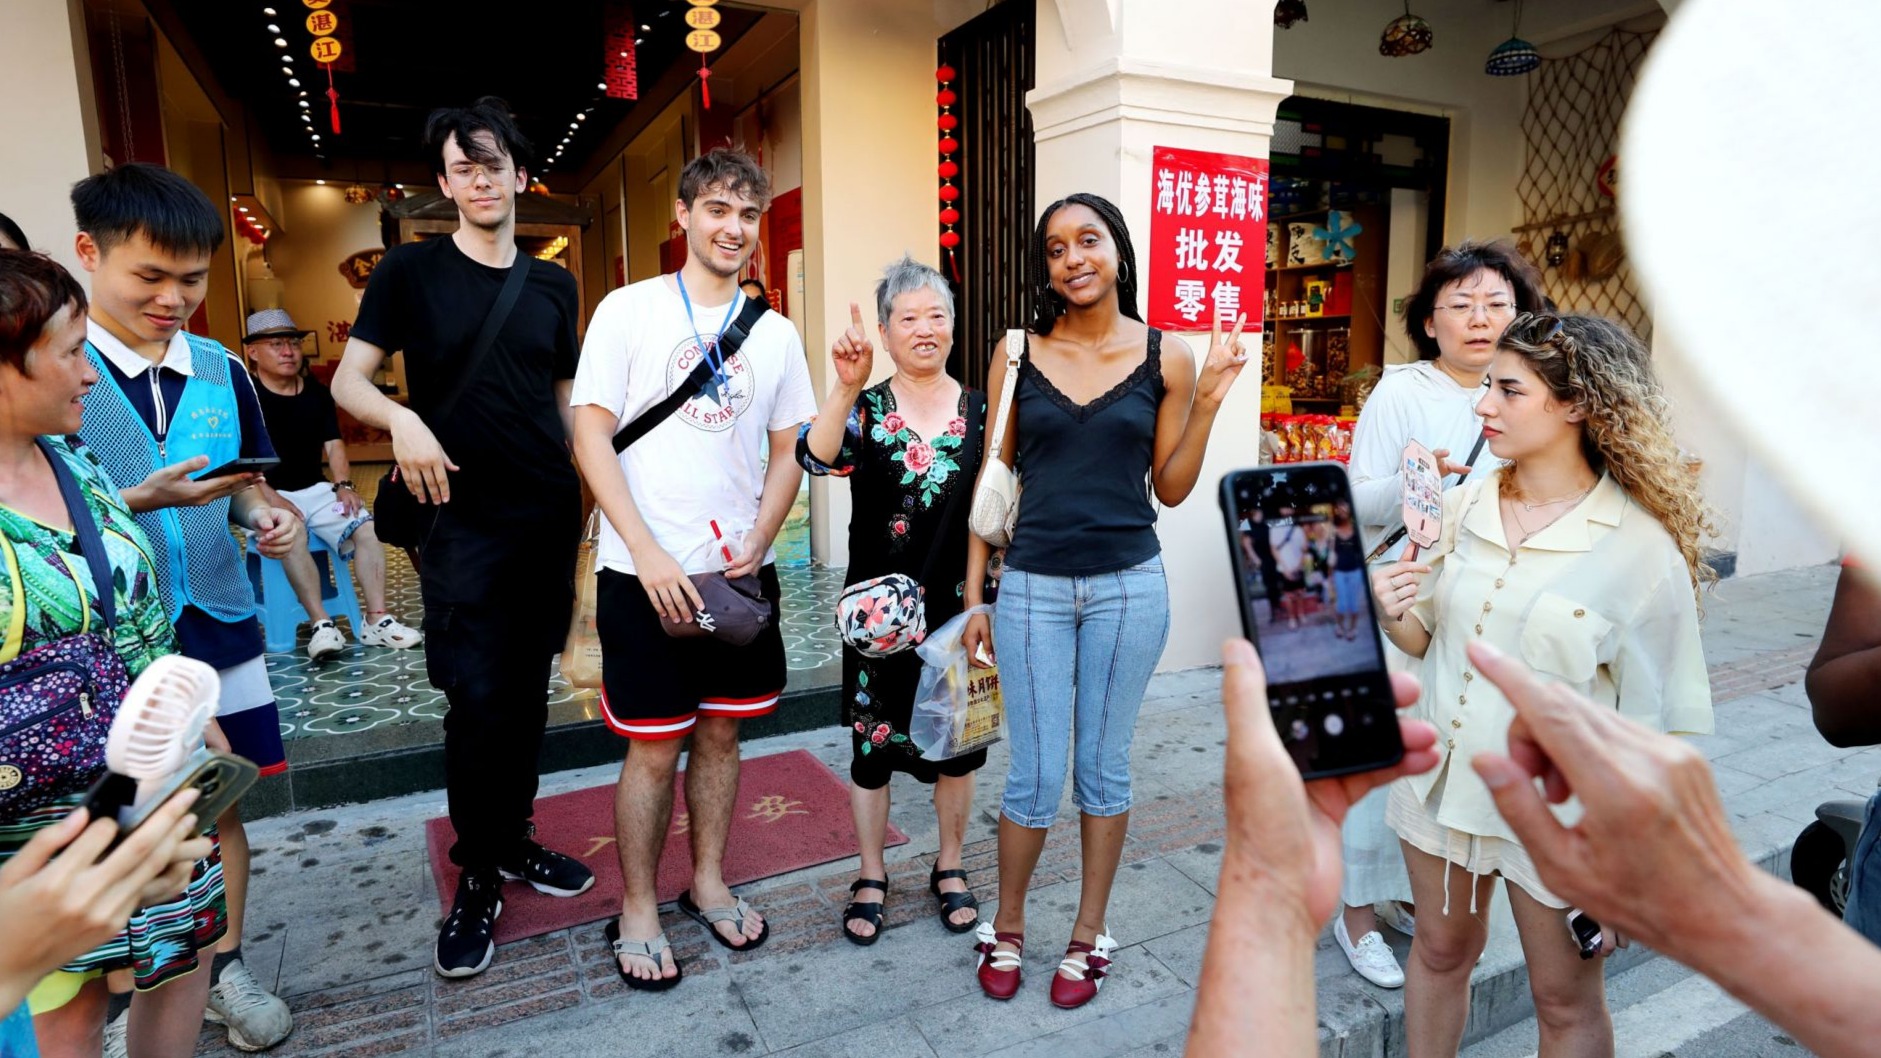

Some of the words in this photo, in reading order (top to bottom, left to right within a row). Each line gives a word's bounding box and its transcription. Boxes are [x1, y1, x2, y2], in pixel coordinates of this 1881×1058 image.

[1156, 168, 1264, 222] 海优参茸海味
[1175, 227, 1244, 273] 批发
[1173, 279, 1241, 322] 零售
[679, 402, 698, 419] LL
